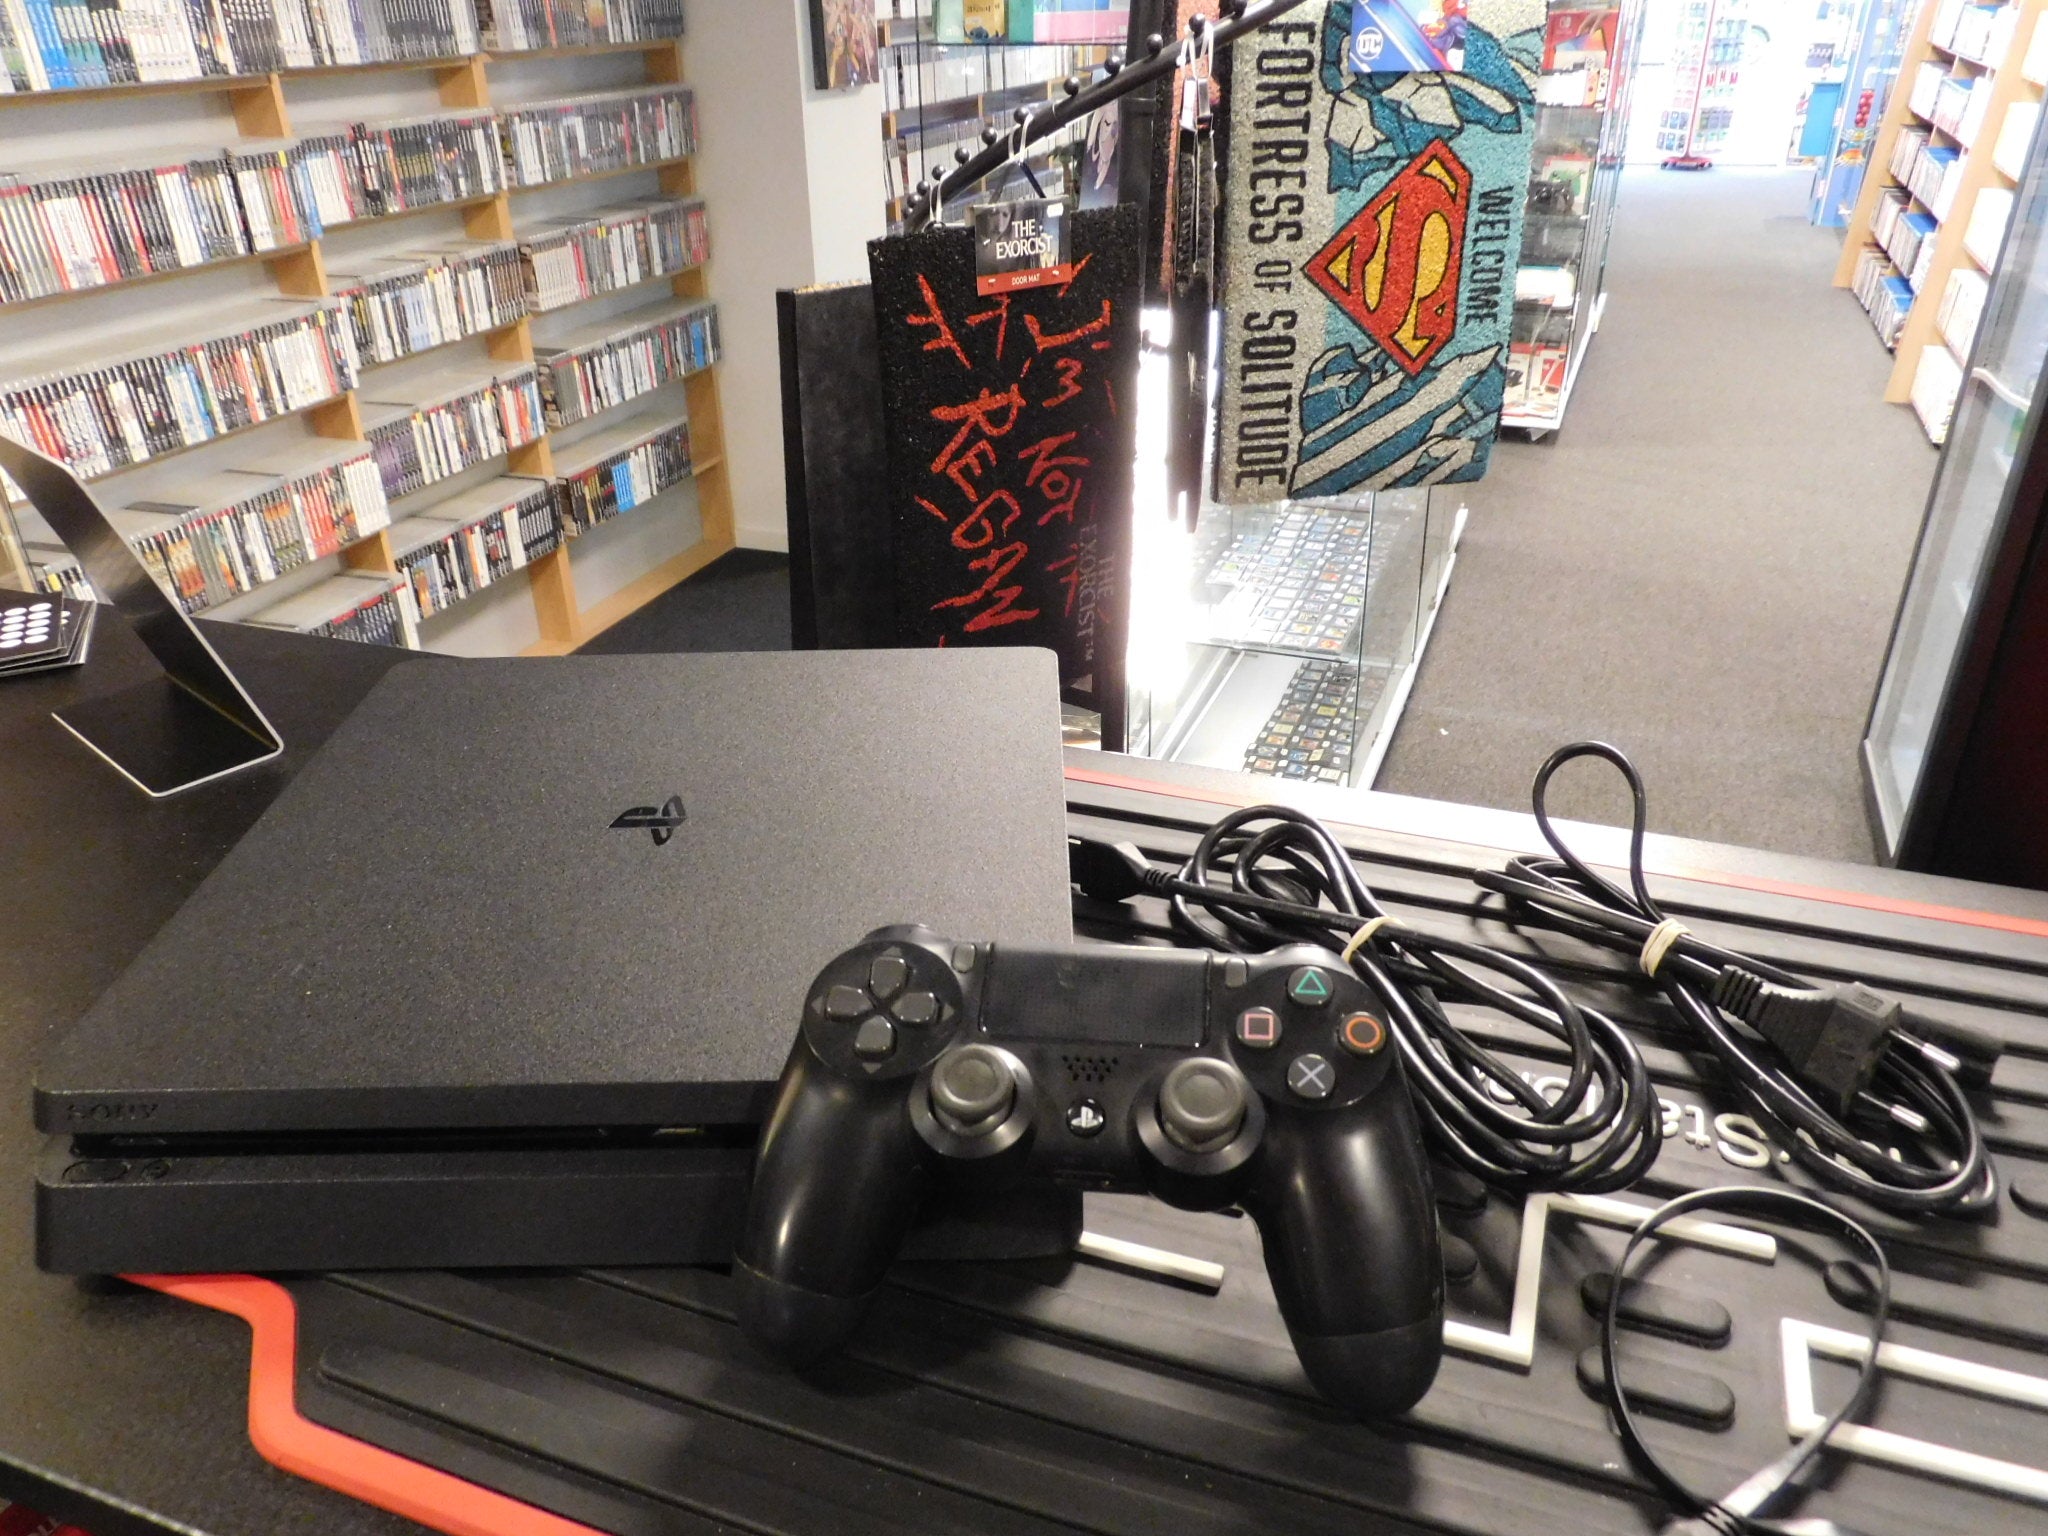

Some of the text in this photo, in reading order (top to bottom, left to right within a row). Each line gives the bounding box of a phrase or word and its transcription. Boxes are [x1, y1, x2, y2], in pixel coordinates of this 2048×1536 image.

[1357, 33, 1383, 55] DC
[1011, 218, 1036, 238] THE
[995, 235, 1053, 260] EXORCIST
[1235, 21, 1317, 489] FORTRESS OF SOLITUDE
[1463, 185, 1514, 326] WELCOME
[1011, 273, 1041, 285] DOOR MAT
[930, 383, 1040, 632] REGAN
